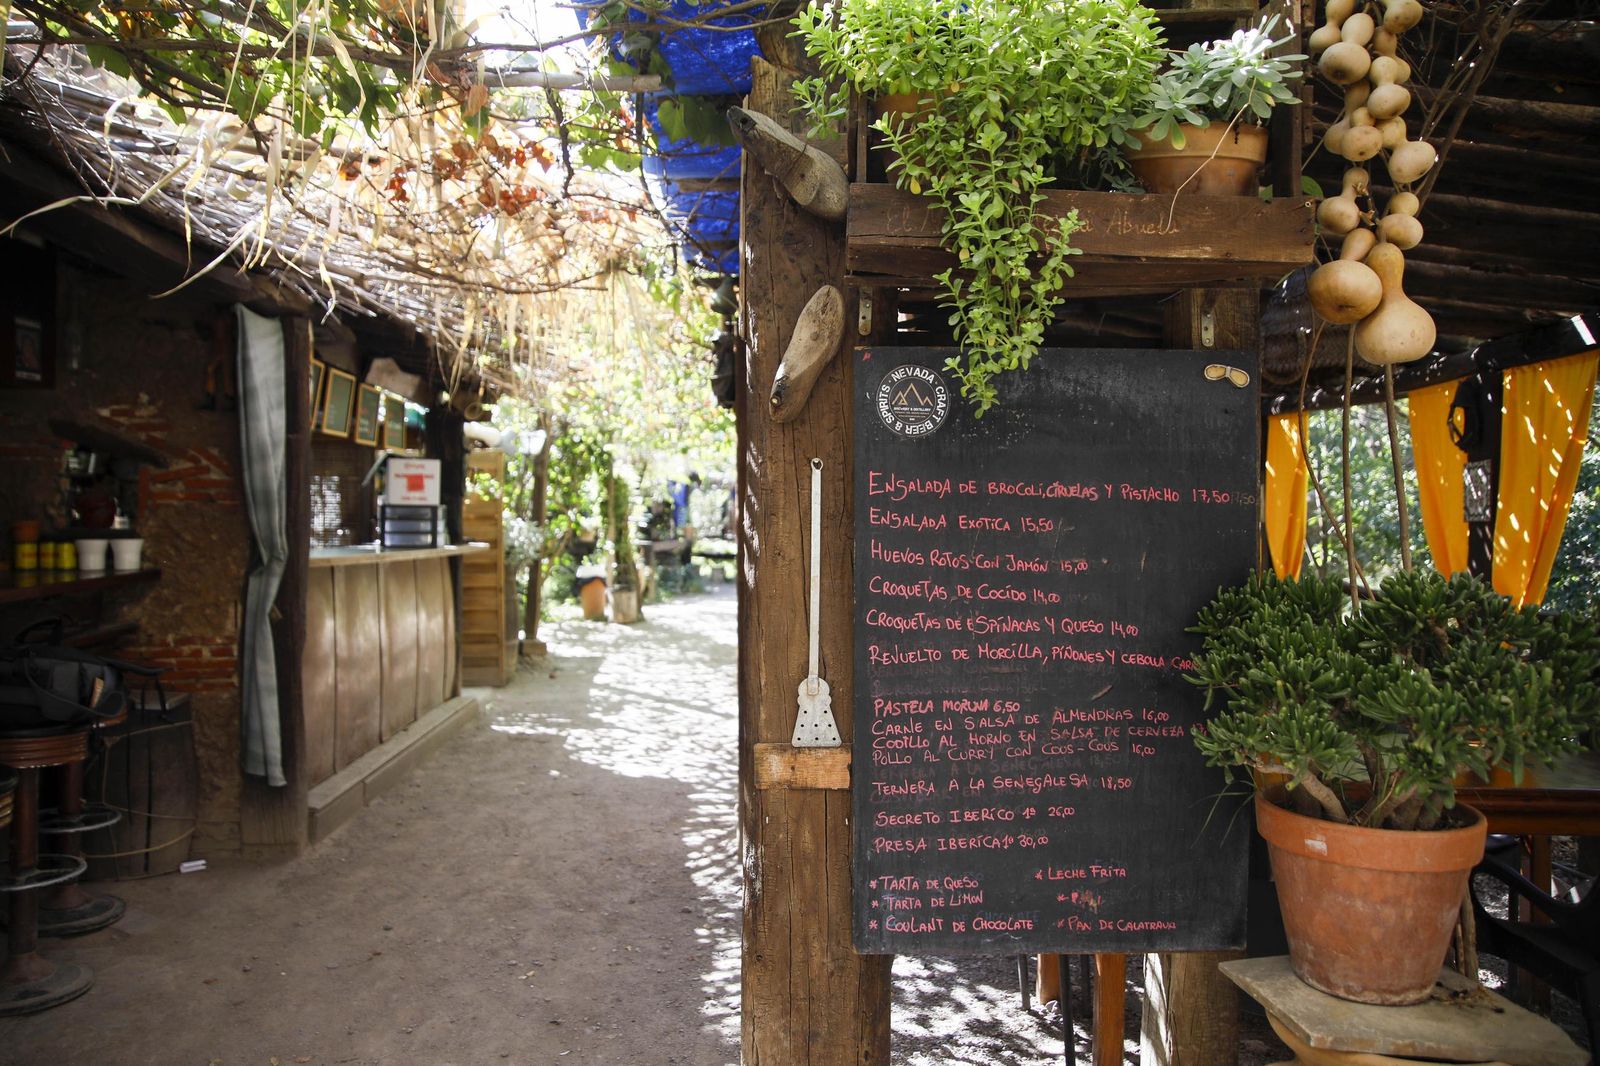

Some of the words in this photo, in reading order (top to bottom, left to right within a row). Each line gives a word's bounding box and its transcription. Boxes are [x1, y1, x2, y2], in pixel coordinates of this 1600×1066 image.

[890, 366, 935, 384] NEVADA
[878, 384, 895, 424] SPIRITS
[932, 386, 947, 423] CRAFT
[894, 421, 903, 431] &
[905, 420, 934, 435] BEER
[869, 471, 951, 501] ENSALADA
[959, 480, 977, 494] DE
[1104, 484, 1112, 499] Y
[1120, 483, 1180, 502] PISTACHO
[1192, 488, 1231, 504] 17,50
[869, 507, 947, 531] ENSALADA
[958, 515, 1011, 531] EXOTICA
[1021, 517, 1054, 533] 15,50
[871, 539, 925, 565] HUEVOS
[930, 549, 969, 569] ROTOS
[975, 554, 1000, 569] CON
[1005, 554, 1048, 572] JAMÓN
[1060, 560, 1089, 575] 15,00
[869, 576, 948, 602] CROQUETAS
[957, 584, 973, 599] DE
[1033, 588, 1061, 605] 14,00
[866, 609, 941, 633] CROQUETAS
[946, 618, 963, 630] DE
[966, 615, 1041, 634] ESPINACAS
[1045, 616, 1055, 634] Y
[1061, 617, 1103, 635] QUESO
[1111, 621, 1139, 638] 14,00
[868, 644, 942, 665] REVUELTO
[952, 648, 970, 660] DE
[1105, 649, 1115, 665] Y
[1121, 653, 1165, 668] CEBOLLA
[873, 699, 934, 717] PASTELA
[943, 699, 990, 714] MORUNA
[993, 700, 1021, 715] 6,50
[871, 717, 923, 736] CARNE
[935, 718, 953, 731] EN
[964, 713, 1016, 730] SALSA
[1025, 714, 1040, 725] DE
[1052, 708, 1133, 725] ALMENDRAS
[1142, 708, 1170, 724] 16,00
[872, 735, 930, 749] CODILLO
[939, 735, 957, 752] AL
[969, 730, 1012, 745] HORNO
[1018, 729, 1036, 742] EN
[1050, 726, 1095, 740] SALSA
[1104, 726, 1120, 737] DE
[1128, 726, 1185, 737] CERVEZA
[872, 750, 912, 766] POLLO
[924, 750, 940, 762] AL
[948, 746, 994, 761] CURRY
[1005, 743, 1032, 758] CON
[1132, 743, 1156, 757] 16,00
[872, 780, 935, 796] TERNERA
[949, 779, 959, 791] A
[969, 777, 985, 789] LA
[992, 773, 1089, 794] SENEGALESA
[1101, 776, 1132, 792] 18,50
[875, 811, 941, 827] SECRETO
[1048, 806, 1075, 818] 26,00
[874, 837, 927, 854] PRESA
[1018, 834, 1049, 849] 30,00
[879, 875, 920, 890] TARTA
[926, 879, 939, 889] DE
[943, 876, 979, 889] QUESO
[1048, 866, 1087, 880] LECHE
[1089, 865, 1127, 879] FRITA
[882, 895, 921, 911] TARTA
[931, 898, 945, 908] DE
[885, 915, 944, 933] COULANT
[952, 920, 966, 932] DE
[972, 917, 1034, 931] CHOCOLATE
[1068, 916, 1092, 931] PAN
[1099, 919, 1114, 930] DE
[1117, 919, 1177, 931] CALATRAVA
